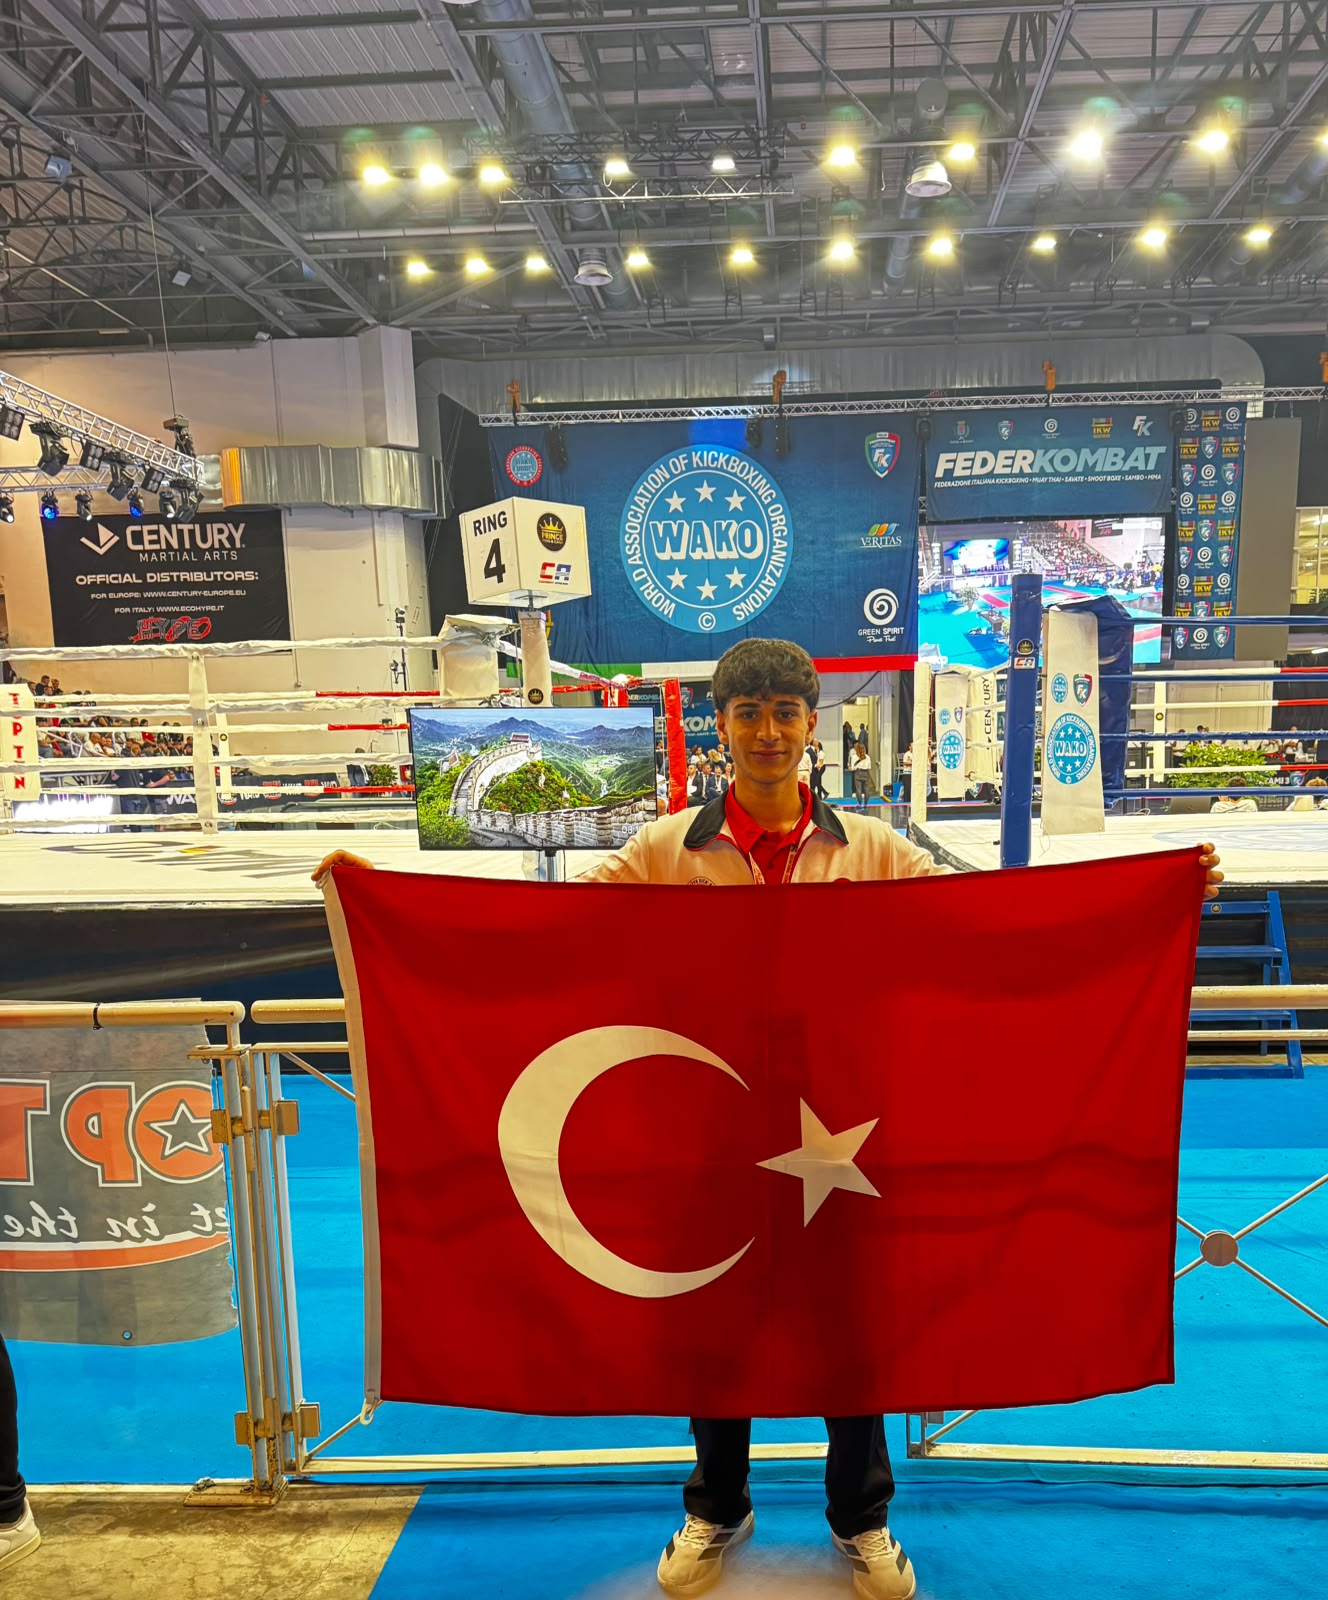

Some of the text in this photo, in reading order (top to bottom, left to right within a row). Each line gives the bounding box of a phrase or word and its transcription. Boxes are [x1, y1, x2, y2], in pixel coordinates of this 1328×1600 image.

[935, 446, 1167, 478] FEDERKOMBAT
[972, 478, 995, 486] ITALIANA
[472, 511, 508, 537] RING
[126, 522, 246, 550] CENTURY
[625, 451, 788, 621] WORLD ASSOCIATION OF KICKBOXING ORGANIZATIONS
[649, 519, 764, 561] WAKO
[139, 551, 238, 563] MARTIAL ARTS
[484, 537, 506, 584] 4
[75, 571, 259, 585] OFFICIAL DISTRIBUTORS:
[91, 592, 108, 600] FOR
[115, 606, 131, 614] FOR
[857, 627, 905, 636] GREEN SPIRIT
[1054, 740, 1087, 757] WAKO
